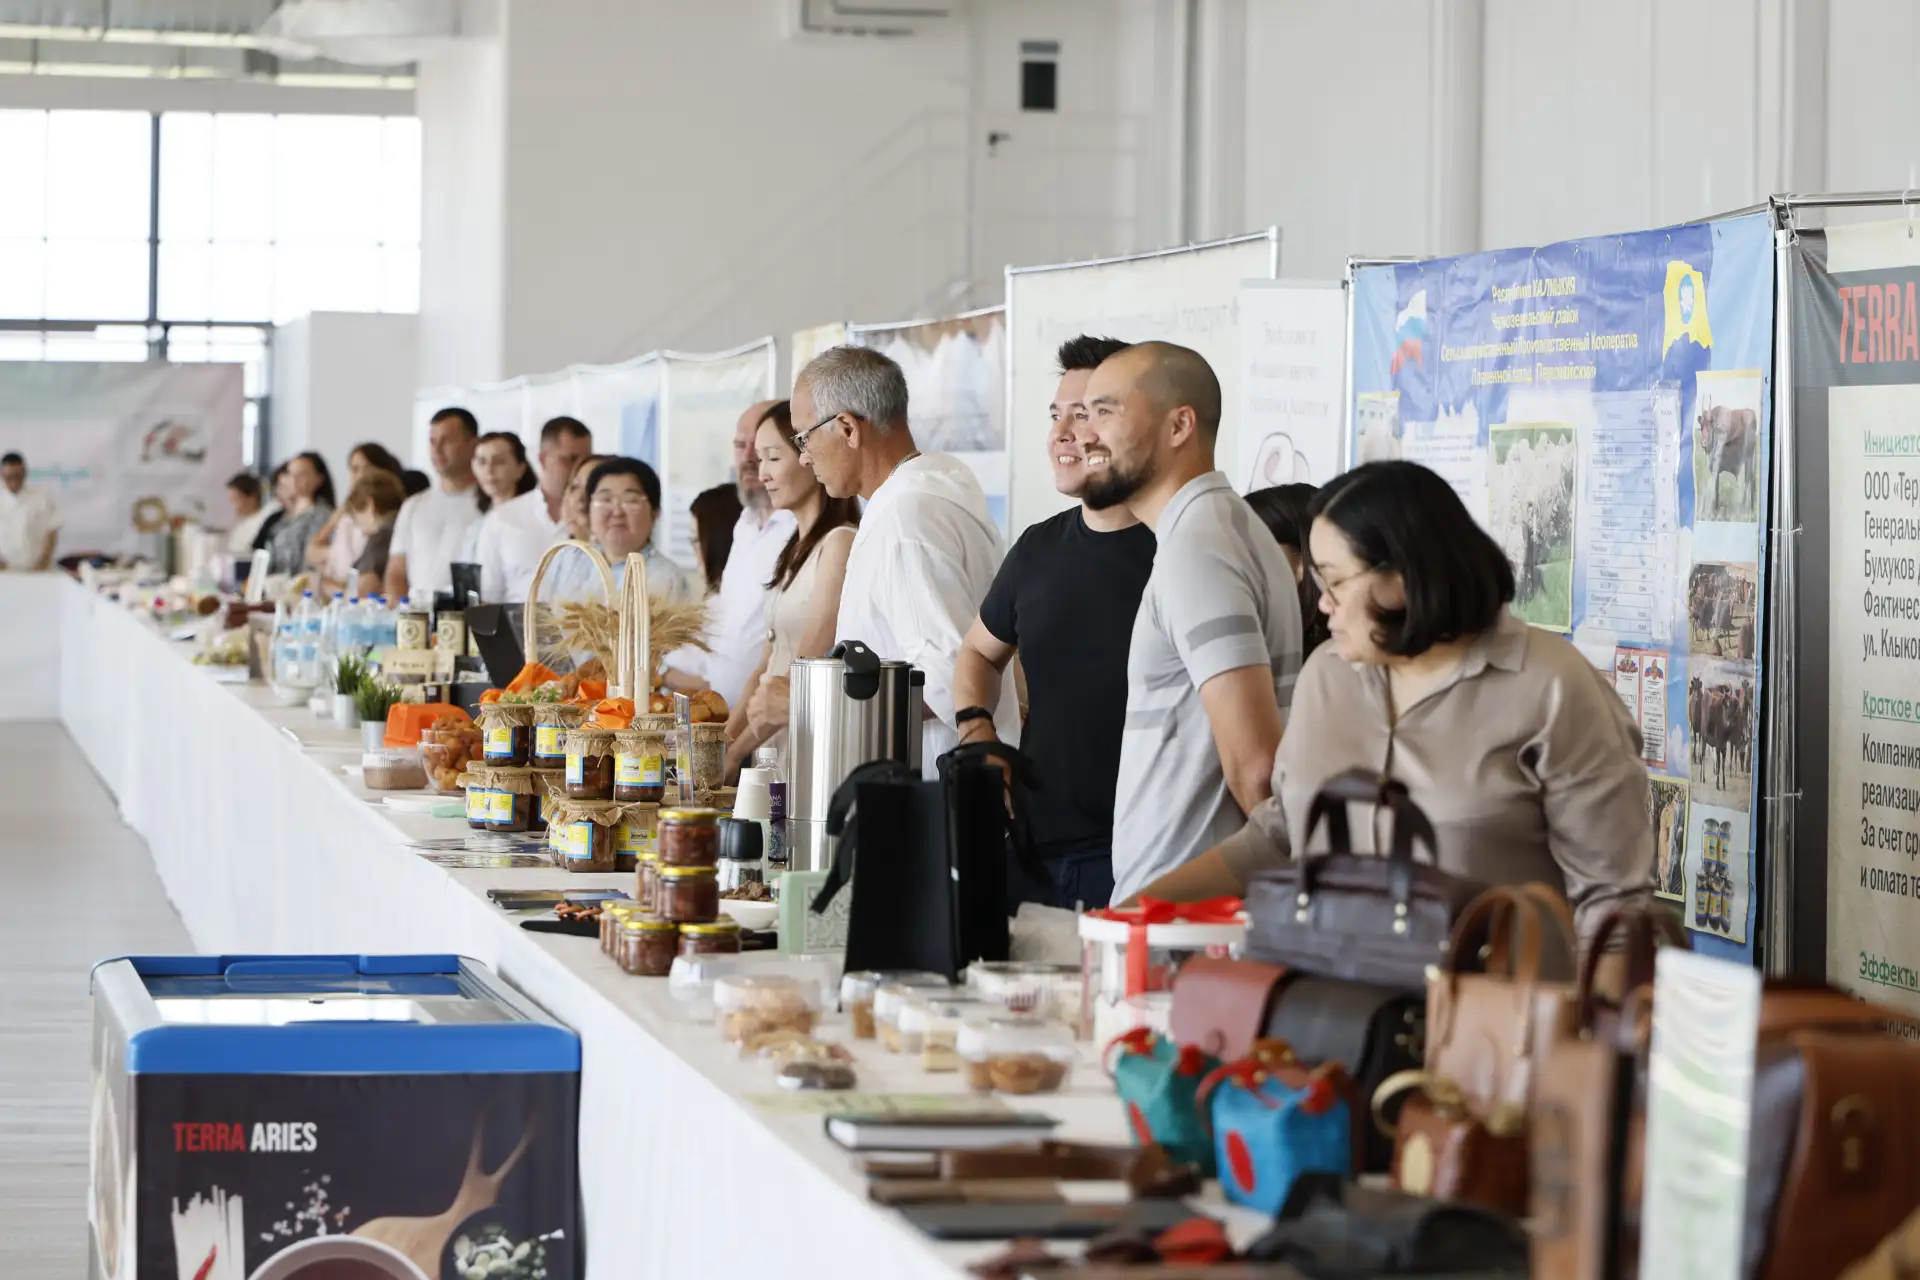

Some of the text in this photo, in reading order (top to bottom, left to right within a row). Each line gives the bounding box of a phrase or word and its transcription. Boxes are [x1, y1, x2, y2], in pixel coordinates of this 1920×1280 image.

[1838, 281, 1920, 364] TERRA
[1864, 471, 1920, 508] ООО «Тер
[1864, 549, 1915, 586] Булхуков
[1863, 587, 1920, 621] Фактичес
[1863, 634, 1878, 662] ул.
[1862, 690, 1912, 720] Краткое
[1862, 733, 1920, 770] Компания
[1860, 816, 1920, 861] За счет ср
[1860, 865, 1867, 887] и
[1870, 867, 1908, 896] оплата
[1859, 951, 1918, 986] Эффекты
[172, 1122, 318, 1153] TERRA ARIES
